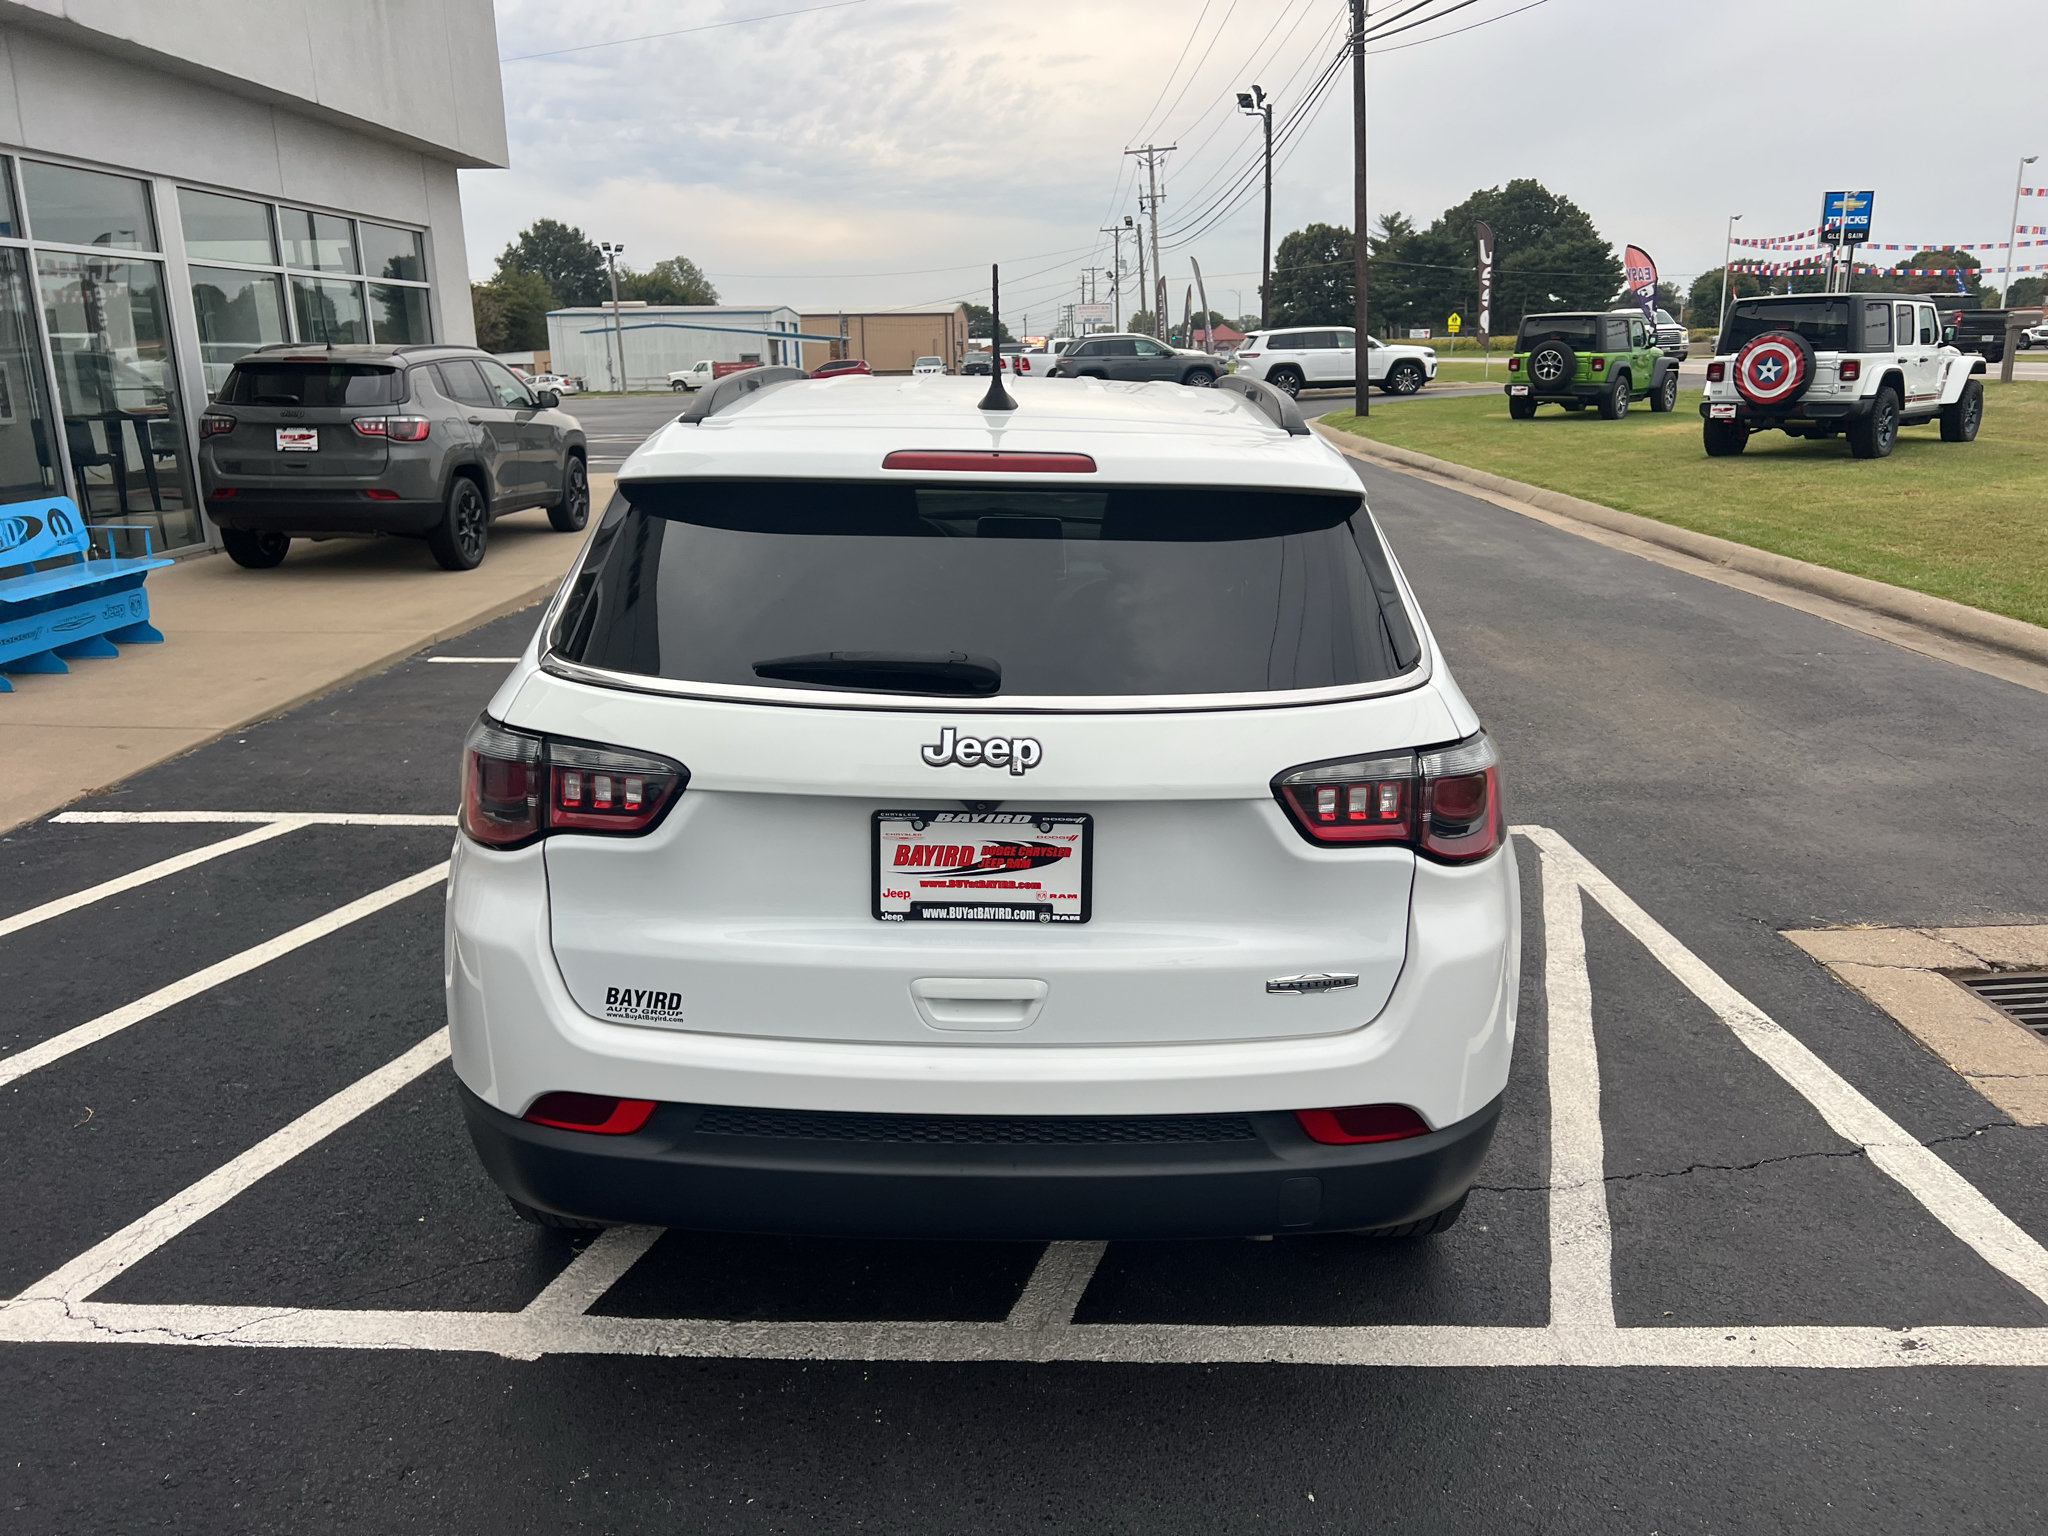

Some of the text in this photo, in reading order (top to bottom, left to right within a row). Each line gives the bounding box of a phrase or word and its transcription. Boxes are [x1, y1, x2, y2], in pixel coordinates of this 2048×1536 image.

[921, 726, 1042, 776] Jeep
[934, 813, 1033, 824] BAYIRD
[893, 844, 975, 867] BAYIRD
[980, 845, 1072, 858] DODGE CHRYSLER
[977, 857, 1032, 869] JEEP RAM
[919, 879, 1042, 890] www.BUYatBAYIRD.com
[882, 888, 911, 899] Jeep
[881, 911, 904, 921] Jeep
[922, 906, 1036, 921] www.BUYatBAYIRD.com
[1276, 978, 1350, 989] LATITUDE
[606, 987, 682, 1010] BAYIRD
[606, 1013, 683, 1022] www.BuyAtBayird.com
